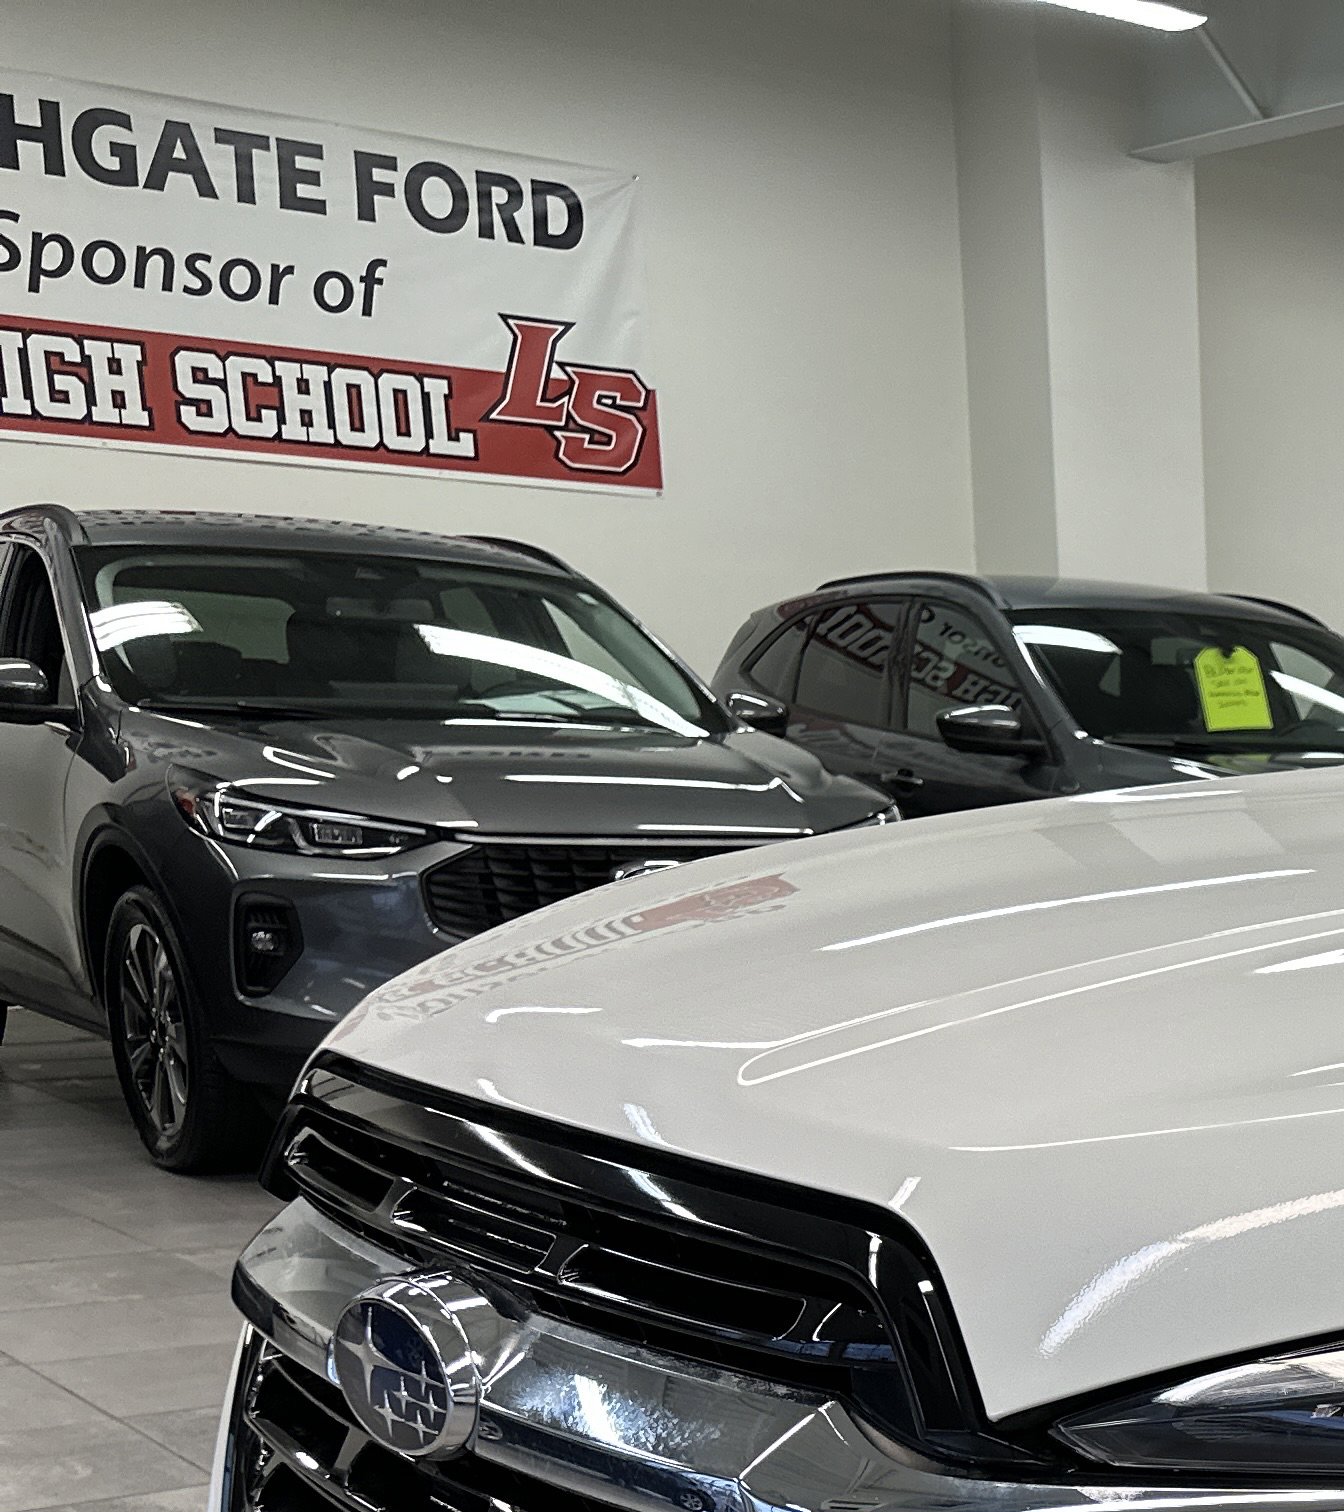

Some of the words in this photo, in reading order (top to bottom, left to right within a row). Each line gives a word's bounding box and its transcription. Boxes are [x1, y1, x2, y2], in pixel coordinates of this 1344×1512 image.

[353, 149, 585, 250] FORD
[312, 258, 388, 318] of
[170, 347, 478, 460] SCHOOL
